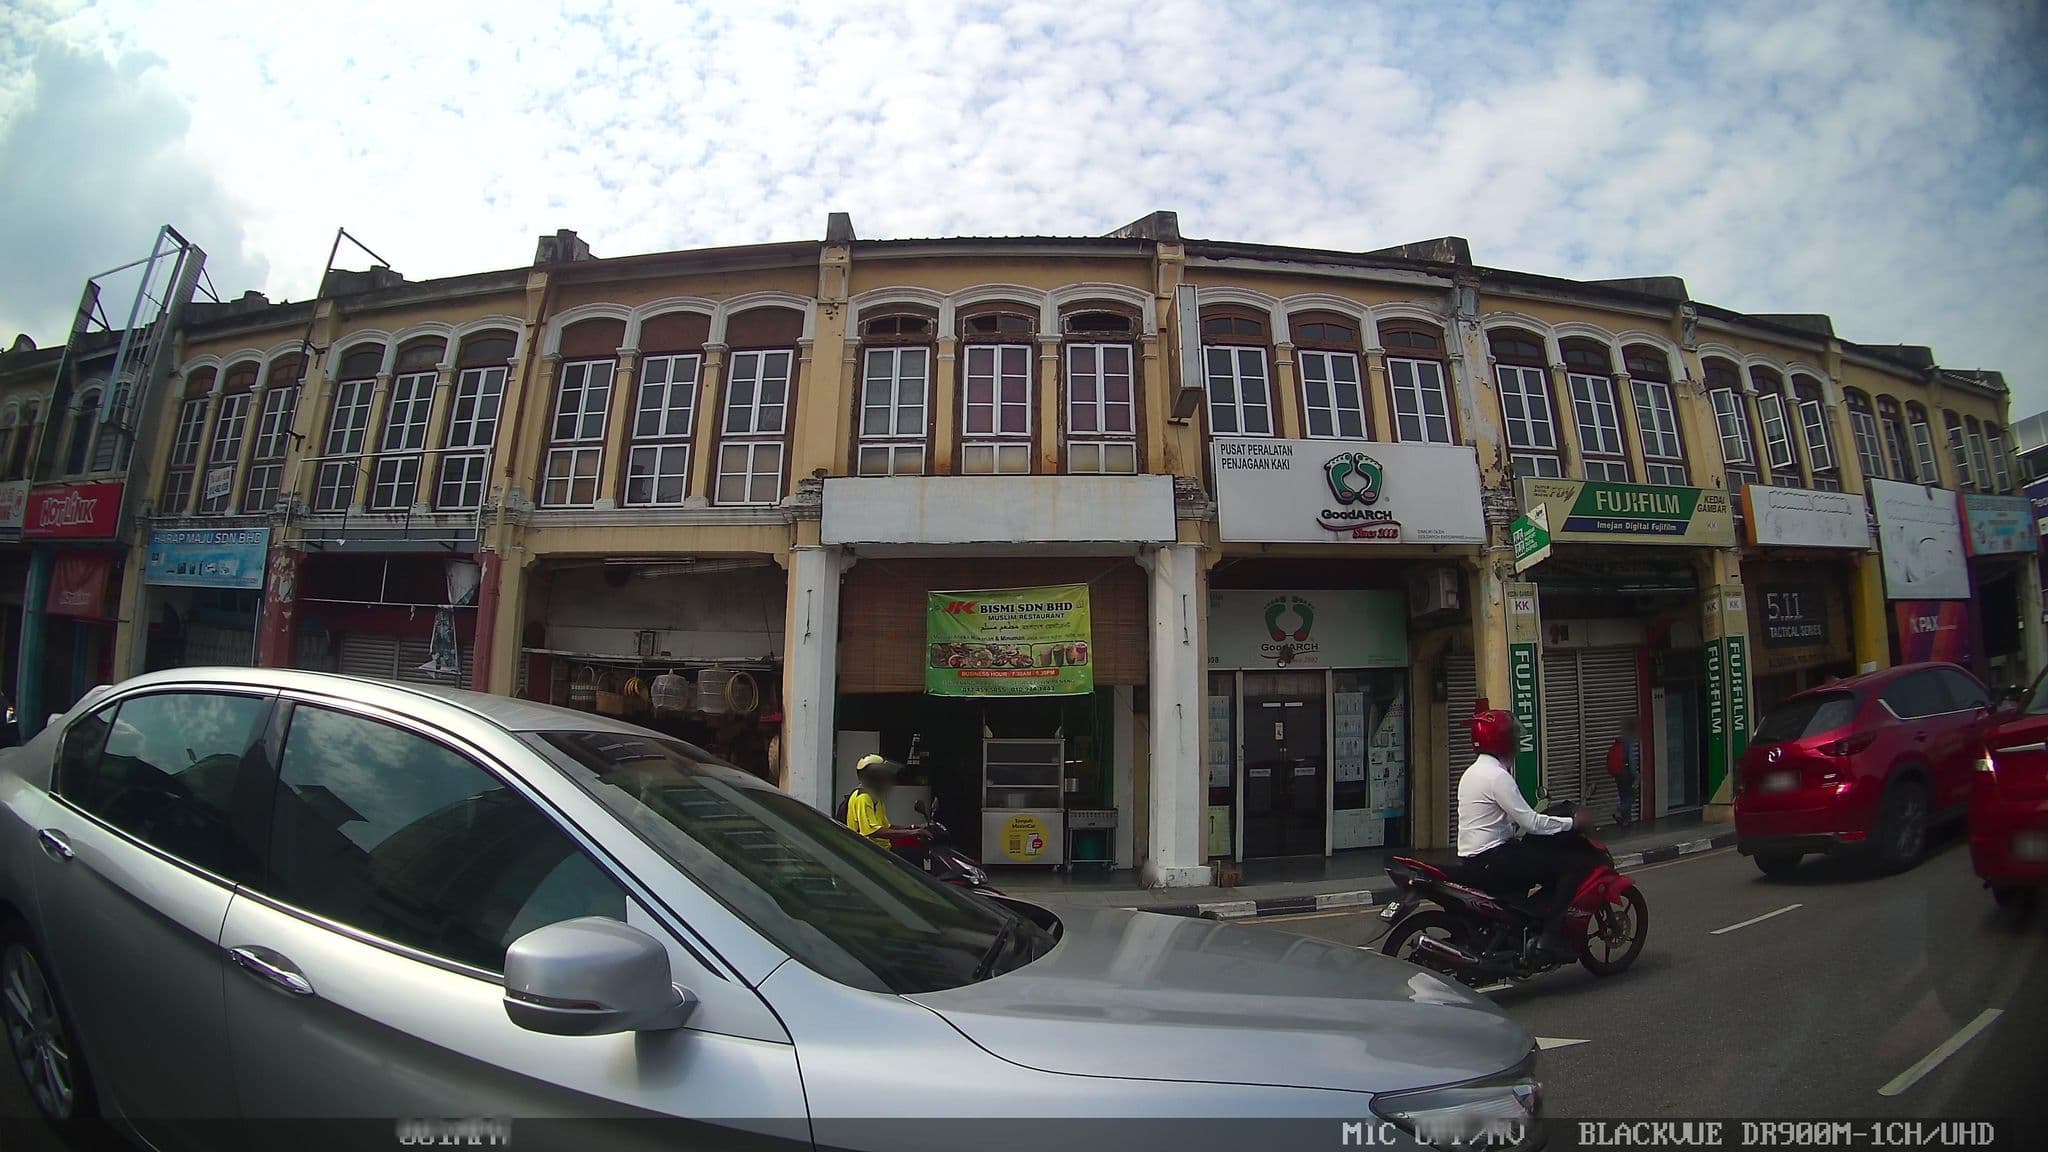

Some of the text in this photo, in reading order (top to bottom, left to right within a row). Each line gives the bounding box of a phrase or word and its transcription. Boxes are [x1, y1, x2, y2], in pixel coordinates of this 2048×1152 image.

[1220, 444, 1293, 456] PUSAT PERALATAN
[1221, 458, 1290, 470] PENJAGAAN KAKI
[1595, 490, 1681, 514] FUJIFILM
[1704, 496, 1725, 504] KEDAI
[1321, 509, 1393, 520] GoodARCH
[1697, 503, 1727, 514] GAMBAR
[1597, 521, 1677, 532] Imejan Digital Fujifilm
[153, 532, 262, 544] HARAP MAJU SDN BHD
[980, 603, 1015, 614] BISMI
[1017, 602, 1043, 613] SDN
[1046, 602, 1073, 612] BHD
[1515, 600, 1529, 610] KK
[1729, 599, 1740, 609] KK
[1766, 592, 1804, 619] 5.11
[1707, 645, 1722, 735] FUJIFILM
[1728, 642, 1744, 731] FUJIFILM
